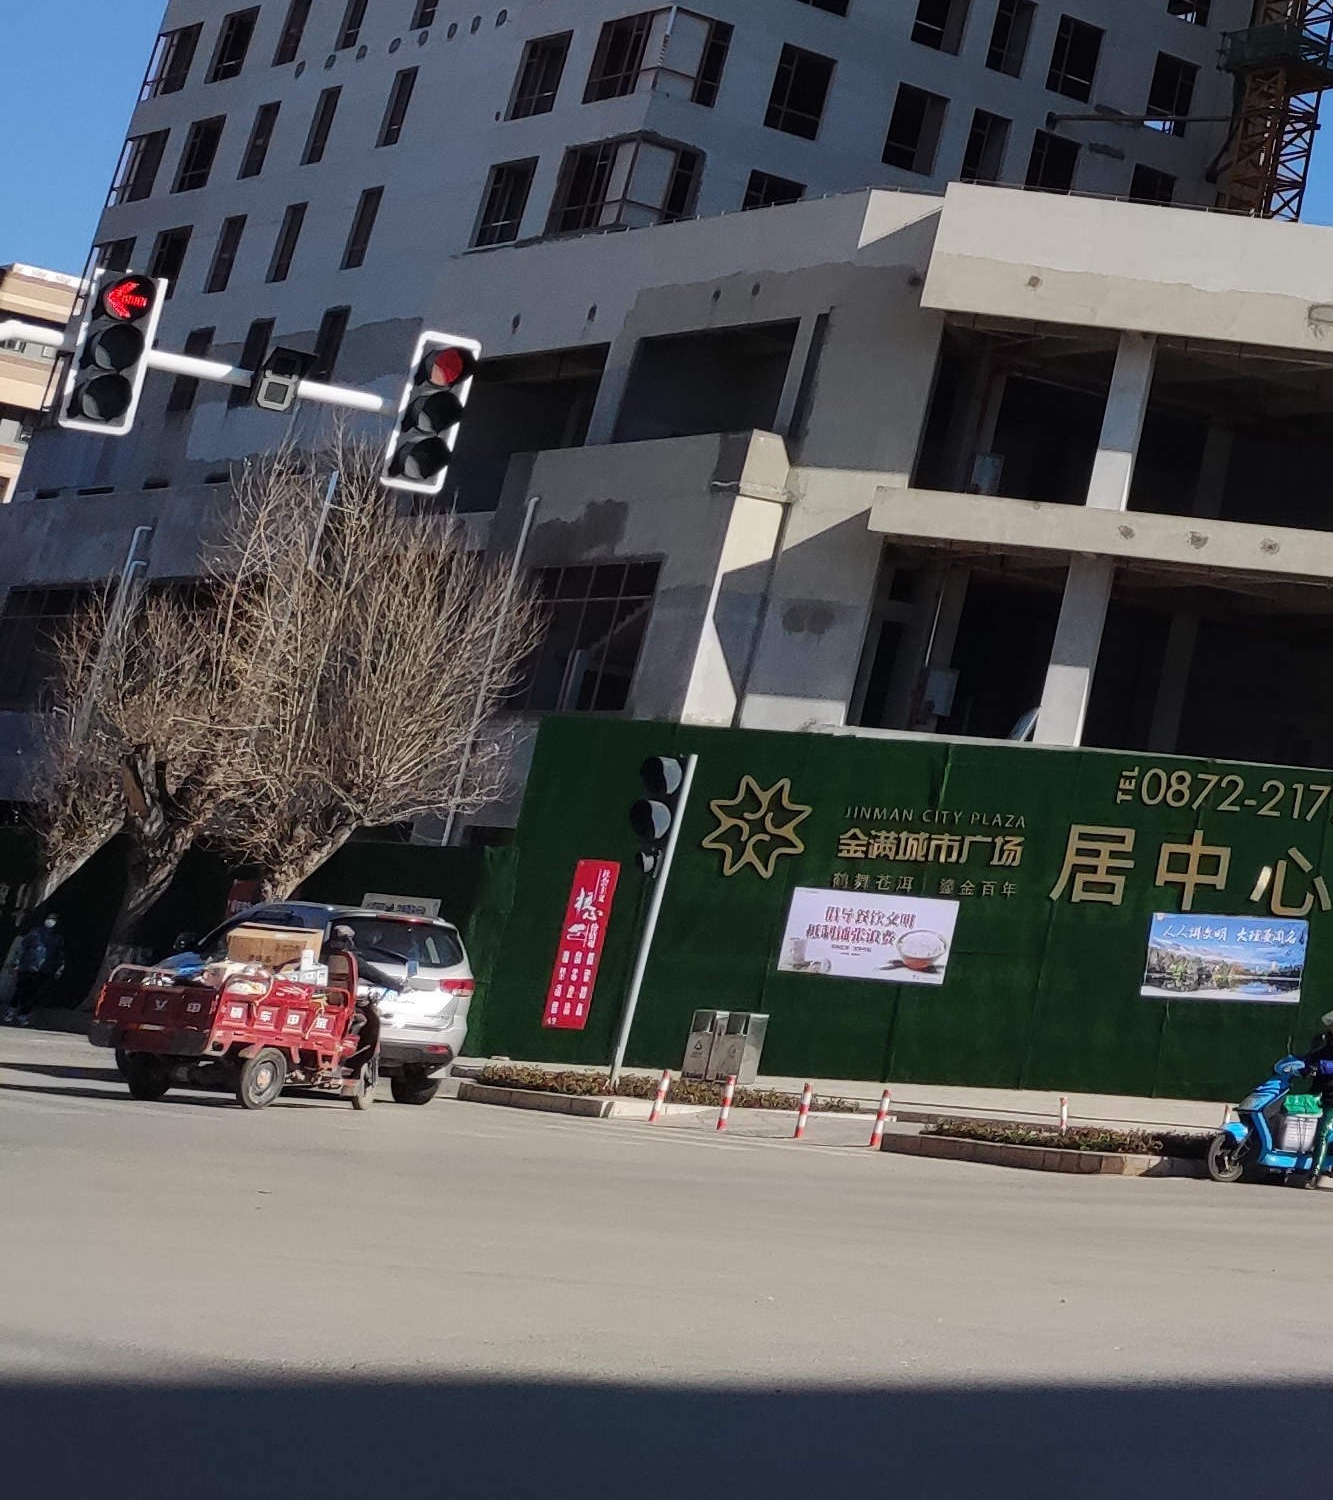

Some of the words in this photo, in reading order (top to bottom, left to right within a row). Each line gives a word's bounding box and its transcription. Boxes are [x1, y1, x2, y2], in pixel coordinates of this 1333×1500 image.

[1116, 766, 1140, 804] TEL
[844, 805, 914, 823] JINMAN
[922, 809, 964, 825] CITY
[970, 811, 1026, 829] PLAZA
[837, 827, 1026, 867] 金满城市广场
[1049, 823, 1332, 916] 居中心
